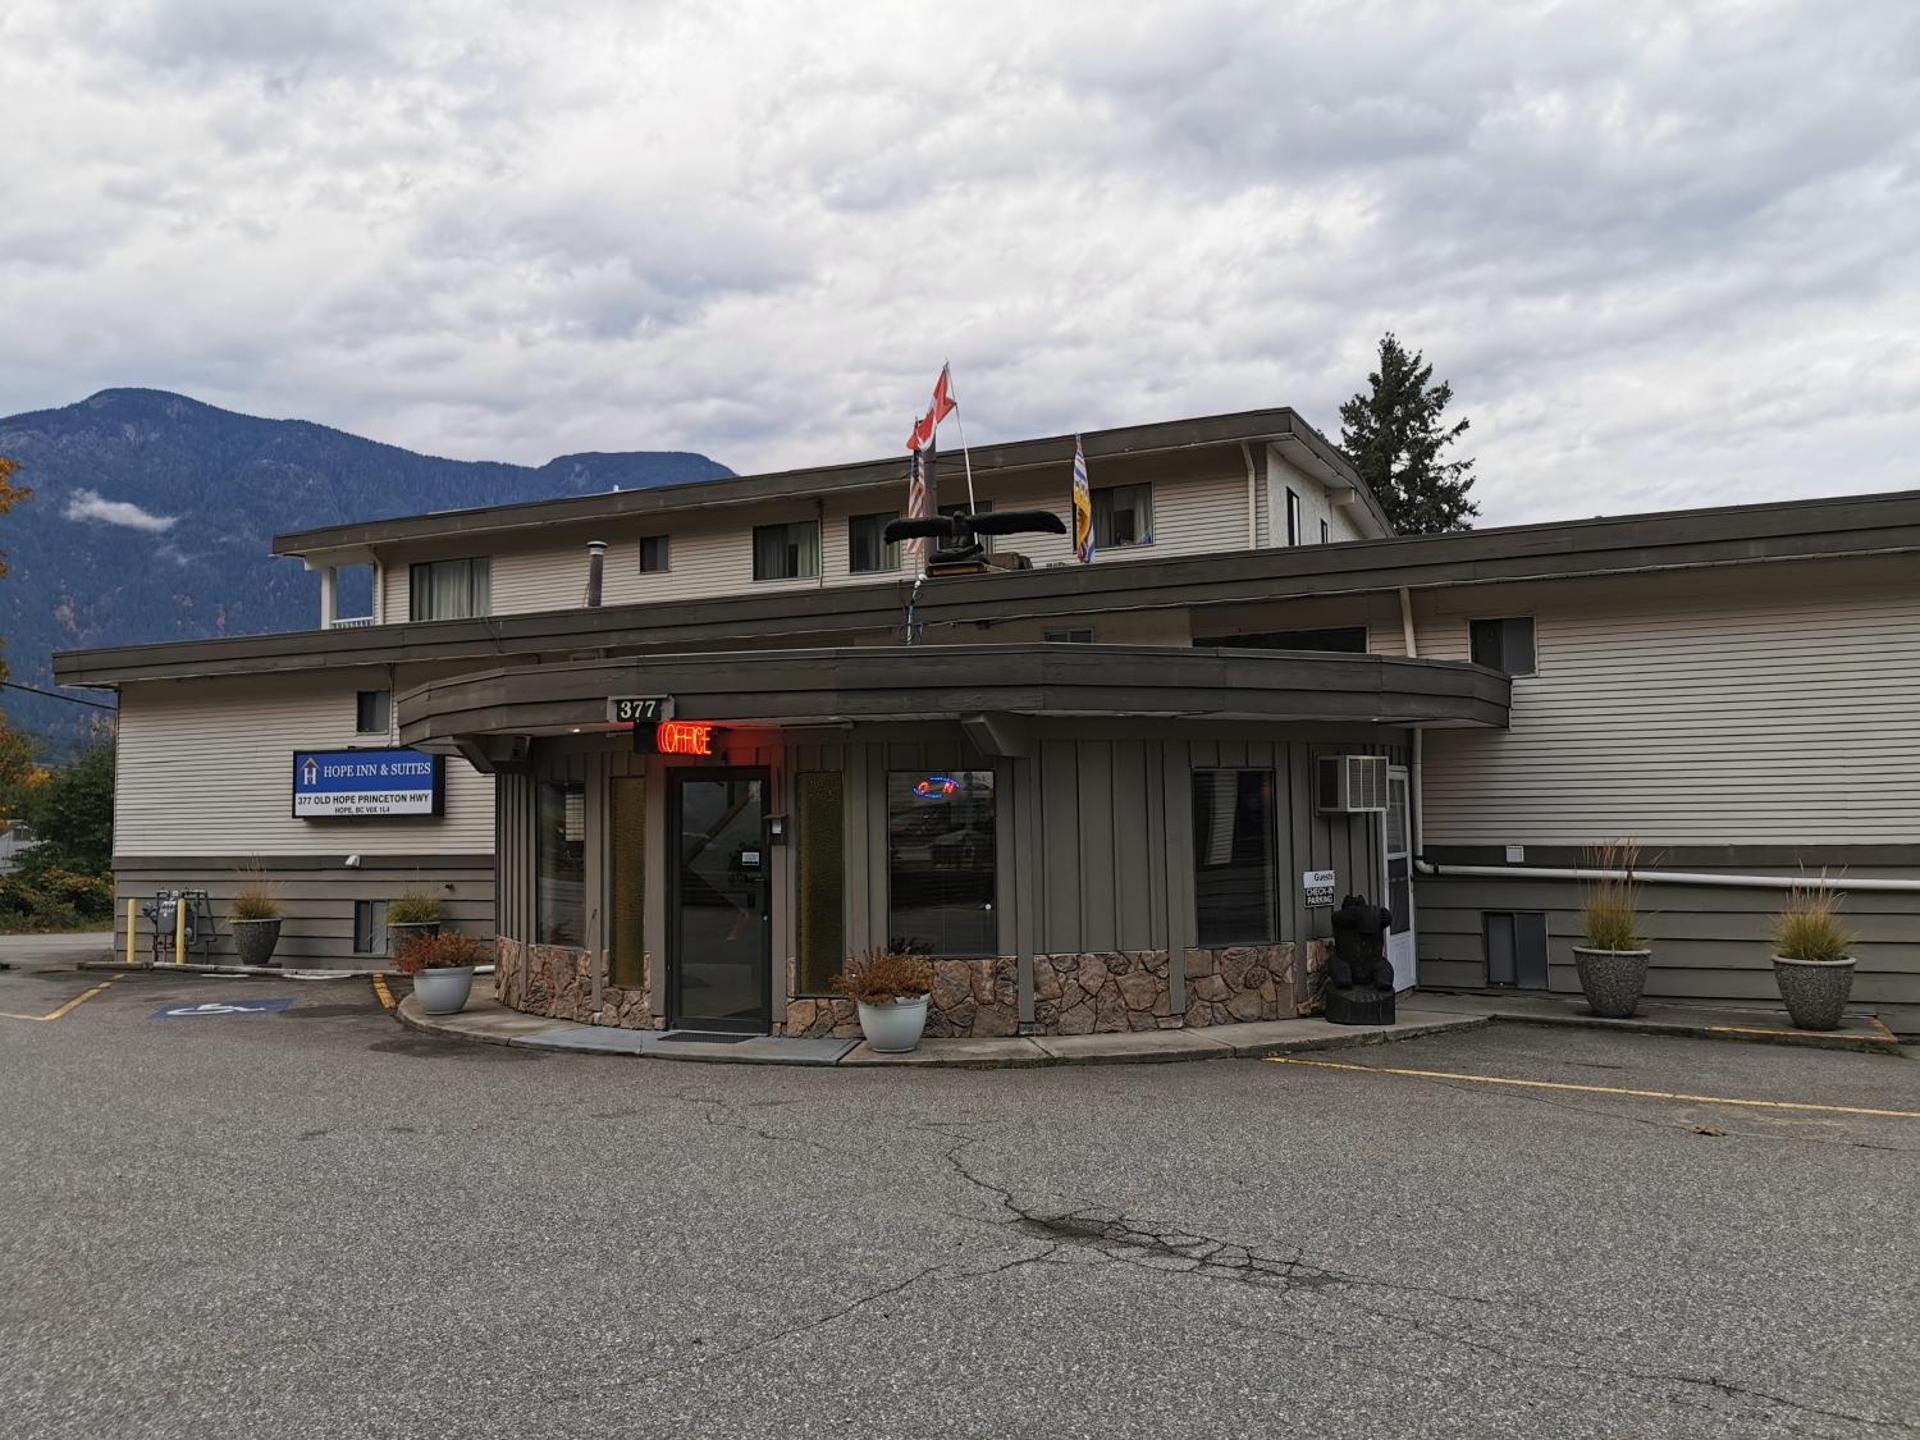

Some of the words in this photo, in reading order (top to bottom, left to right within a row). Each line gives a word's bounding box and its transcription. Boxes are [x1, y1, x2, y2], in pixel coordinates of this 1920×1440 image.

[620, 700, 656, 719] 377
[665, 724, 712, 754] OFFICE
[324, 765, 354, 778] HOPE
[356, 764, 377, 777] INN
[380, 764, 389, 776] &
[391, 762, 431, 776] SUITES
[298, 797, 312, 805] 377
[314, 796, 331, 805] OLD
[333, 795, 355, 804] HOPE
[358, 794, 407, 804] PRINCETON
[409, 793, 429, 803] HWY
